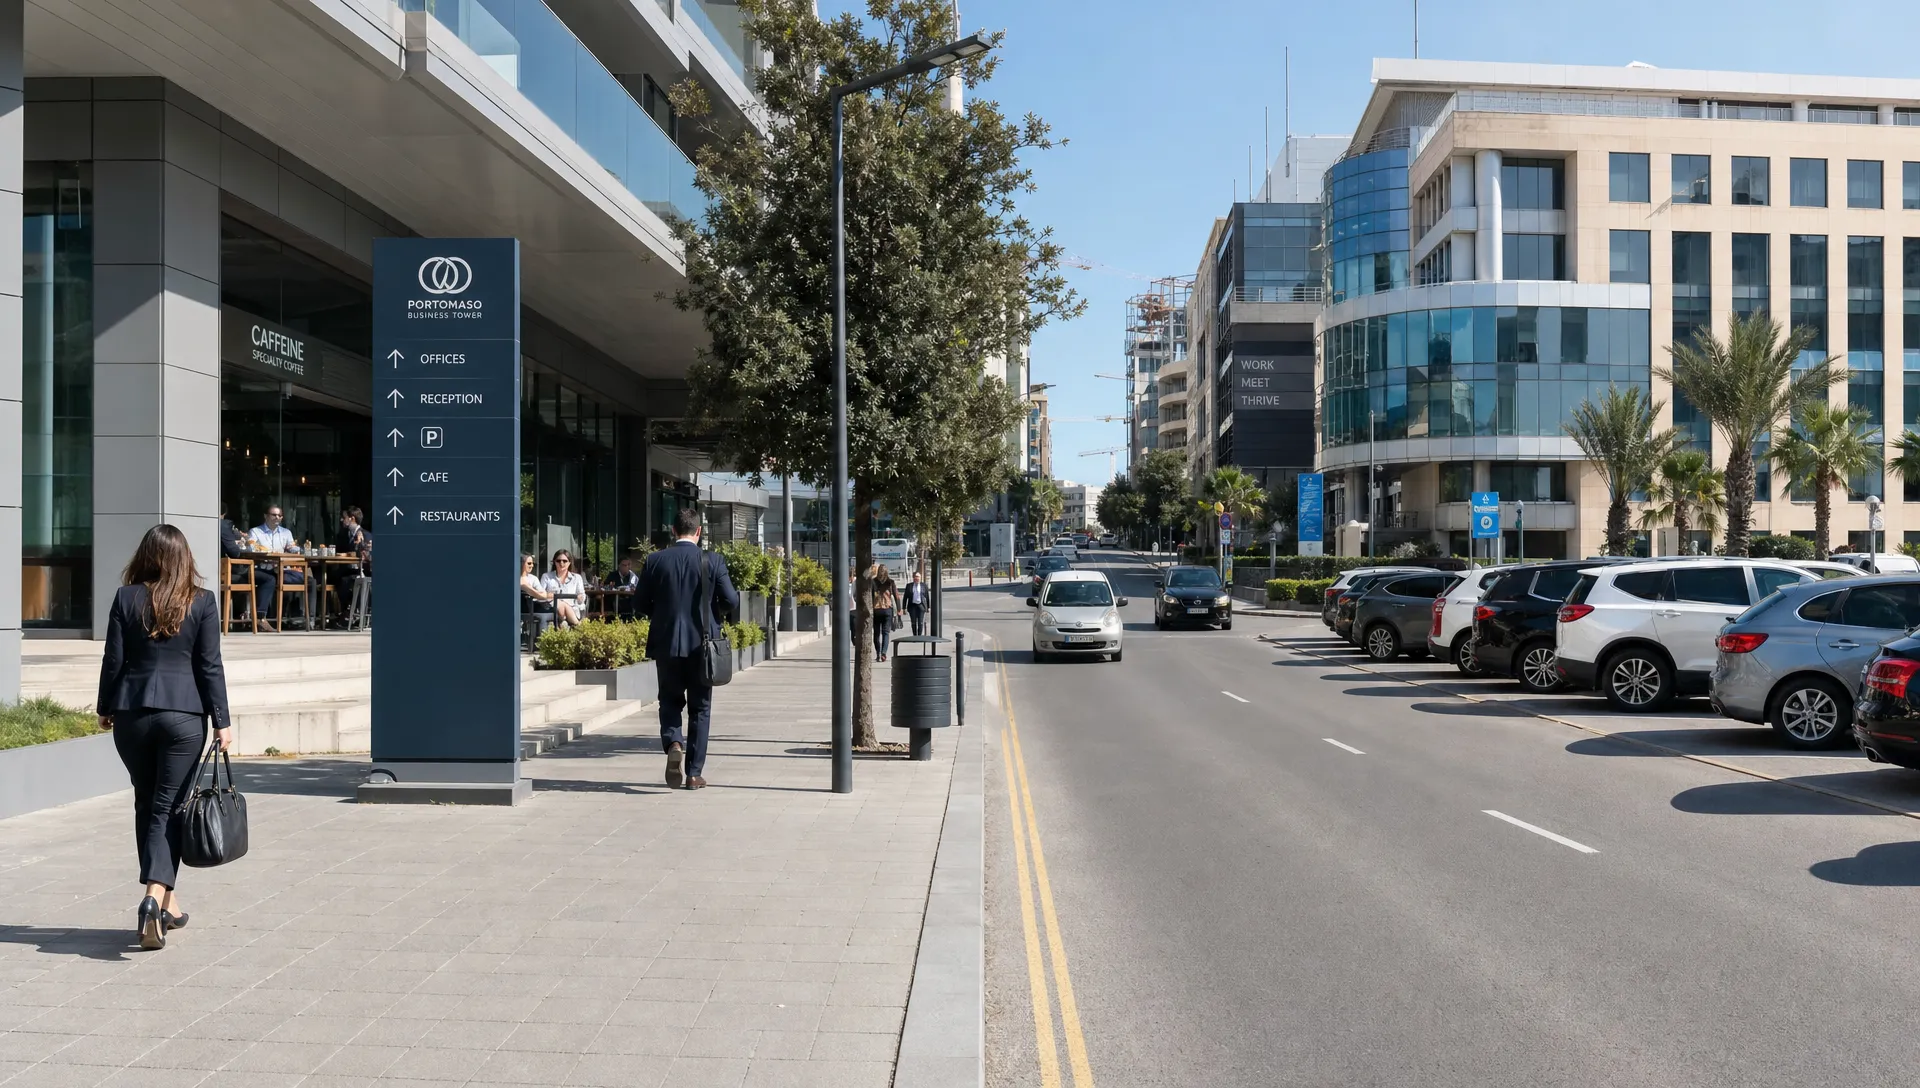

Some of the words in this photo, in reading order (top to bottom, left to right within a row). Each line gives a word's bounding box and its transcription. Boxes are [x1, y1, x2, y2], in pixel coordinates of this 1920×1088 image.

[408, 299, 483, 310] PORTOMASO
[407, 311, 449, 319] BUSINESS
[453, 311, 482, 319] TOWER
[251, 325, 304, 361] CAFFEINE
[420, 353, 466, 364] OFFICES
[283, 359, 304, 375] COFFEE
[1240, 360, 1275, 370] WORK
[1241, 378, 1270, 388] MEET
[420, 393, 483, 404] RECEPTION
[1241, 396, 1280, 405] THRIVE
[426, 430, 438, 445] P
[420, 472, 449, 482] CAFE
[420, 511, 501, 522] RESTAURANTS
